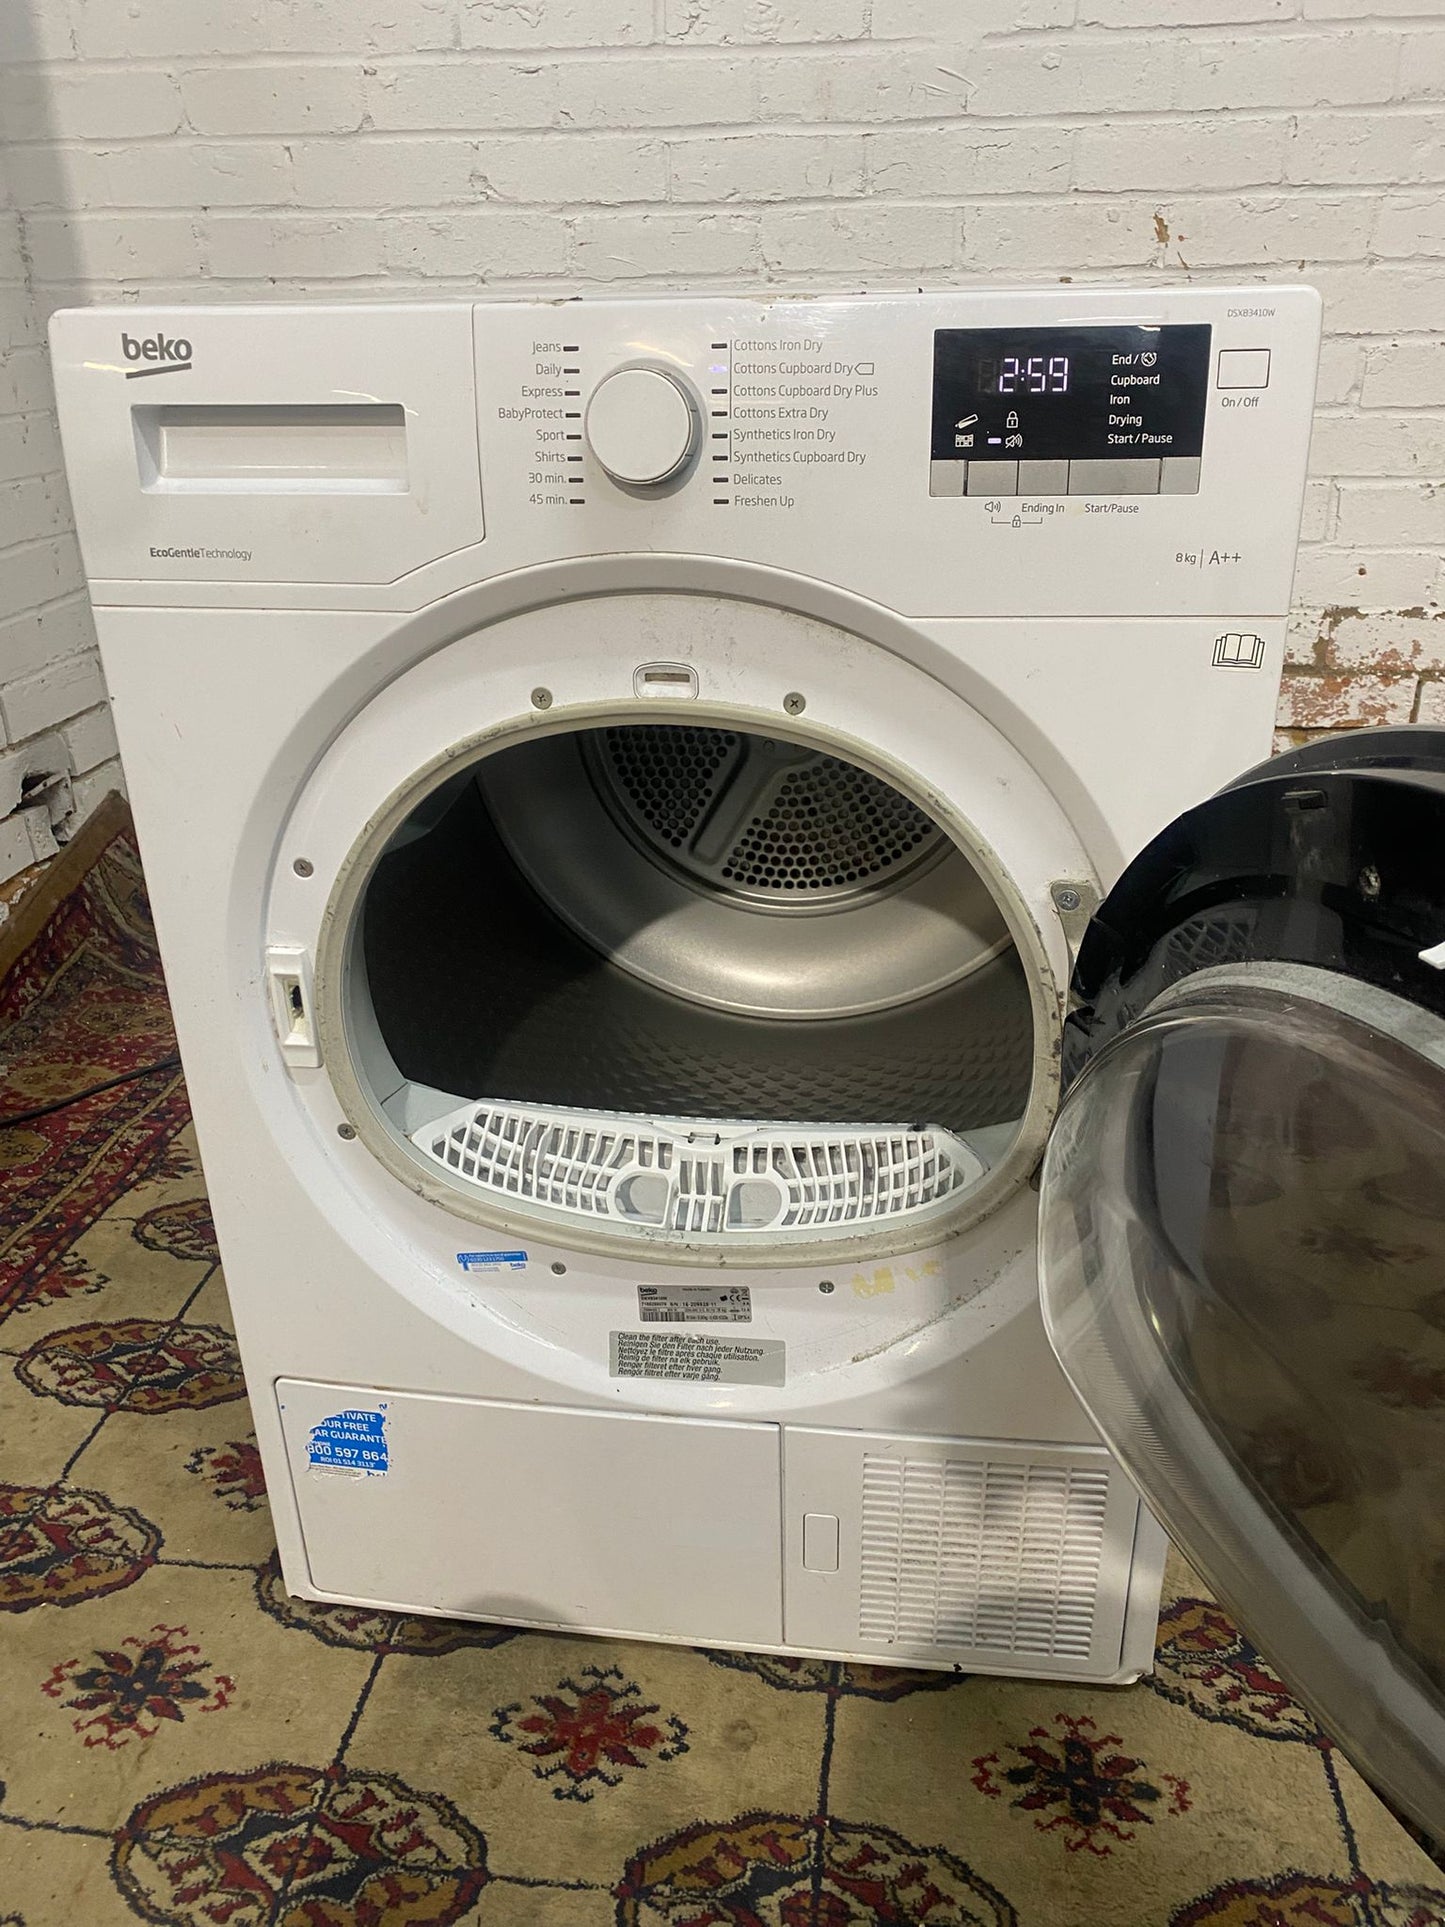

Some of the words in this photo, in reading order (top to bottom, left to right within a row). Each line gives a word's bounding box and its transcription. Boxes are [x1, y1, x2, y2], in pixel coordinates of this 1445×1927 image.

[121, 333, 192, 361] beko
[532, 341, 562, 355] Jeans
[734, 338, 777, 351] Cottons
[779, 339, 801, 351] Iron
[804, 339, 823, 354] Dry
[1111, 353, 1132, 365] End
[536, 363, 562, 377] Daily
[734, 361, 777, 374] Cottons
[779, 362, 831, 377] Cupboard
[834, 361, 854, 377] Dry
[999, 357, 1069, 393] 2:59
[1110, 374, 1160, 388] Cupboard
[521, 385, 564, 400] Express
[734, 384, 777, 397] Cottons
[779, 384, 831, 399] Cupboard
[834, 385, 852, 400] Dry
[855, 385, 879, 397] Plus
[1109, 394, 1131, 405] Iron
[498, 407, 564, 422] BabyProtect
[734, 406, 777, 419] Cottons
[779, 406, 807, 419] Extra
[810, 406, 829, 422] Dry
[1108, 413, 1143, 427] Drying
[536, 429, 565, 443] Sport
[734, 428, 791, 443] Synthetics
[794, 428, 814, 441] Iron
[817, 428, 836, 443] Dry
[535, 450, 566, 462] Shirts
[734, 450, 791, 465] Synthetics
[793, 451, 845, 465] Cupboard
[847, 451, 867, 466] Dry
[528, 472, 543, 484] 30
[544, 472, 567, 484] min.
[733, 473, 783, 486] Delicates
[529, 493, 544, 505] 45
[545, 493, 568, 505] min.
[734, 495, 777, 507] Freshen
[779, 496, 795, 509] Up
[1021, 502, 1054, 516] Ending
[1055, 503, 1065, 513] In
[1084, 502, 1140, 514] Start/Pause
[149, 546, 253, 562] EcoGentleTechnology
[1208, 550, 1242, 565] A++
[618, 1333, 638, 1341] Clean
[618, 1340, 648, 1349] Reinigen
[677, 1343, 695, 1351] Filter
[618, 1347, 649, 1355] Nettoyez
[658, 1348, 674, 1356] filtre
[696, 1351, 722, 1359] chaque
[723, 1353, 759, 1361] utilisation.
[618, 1354, 640, 1362] Reinig
[682, 1371, 700, 1380] varje
[342, 1421, 370, 1432] FREE
[334, 1447, 359, 1459] 597
